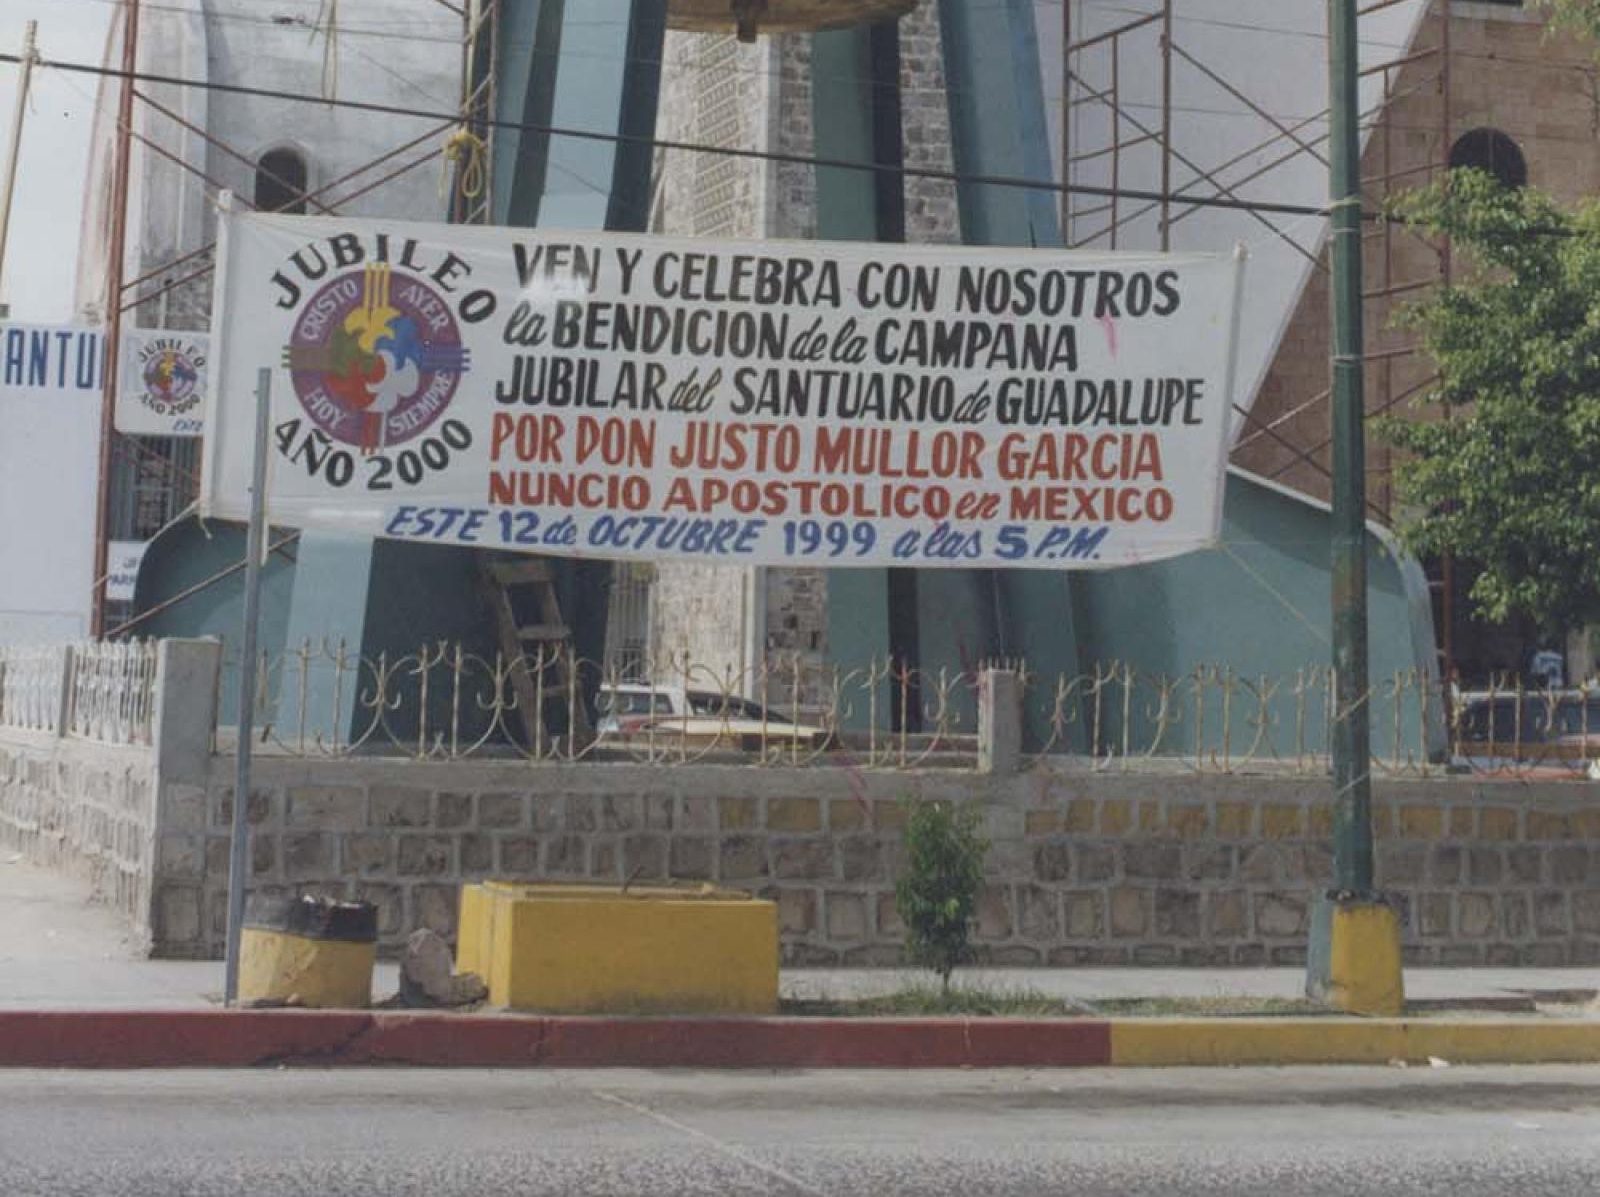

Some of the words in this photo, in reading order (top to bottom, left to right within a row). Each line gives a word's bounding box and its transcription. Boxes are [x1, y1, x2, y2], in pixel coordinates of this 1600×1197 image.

[270, 232, 497, 323] JUBILEO
[301, 279, 358, 340] CRISTO
[400, 284, 449, 332] AYER
[616, 248, 642, 292] Y
[653, 252, 840, 307] CELEBRA
[857, 262, 940, 312] CON
[956, 266, 1180, 317] NOSOTROS
[0, 328, 104, 390] ANTU
[553, 301, 788, 360] BENDICION
[875, 319, 1077, 371] CAMPANA
[304, 387, 347, 429] HOY
[389, 370, 451, 435] SIEMPRE
[496, 356, 666, 411] JUBILAR
[668, 367, 722, 413] del
[730, 367, 954, 422] SANTUARIO
[997, 378, 1203, 425] GUADALUPE
[275, 418, 354, 487] AÑO
[367, 419, 472, 490] 2000
[491, 412, 564, 463] POR
[575, 415, 656, 467] DON
[670, 419, 800, 471] JUSTO
[815, 428, 985, 479] MULLOR
[997, 432, 1162, 481] GARCIA
[488, 470, 650, 510] NUNCIO
[661, 477, 949, 520] APOSTOLICO
[1010, 486, 1172, 521] MEXICO
[386, 506, 491, 539] ESTE
[500, 511, 539, 543] 12
[588, 514, 766, 554] OCTUBRE
[784, 521, 876, 557] 1999
[994, 527, 1028, 560] 5
